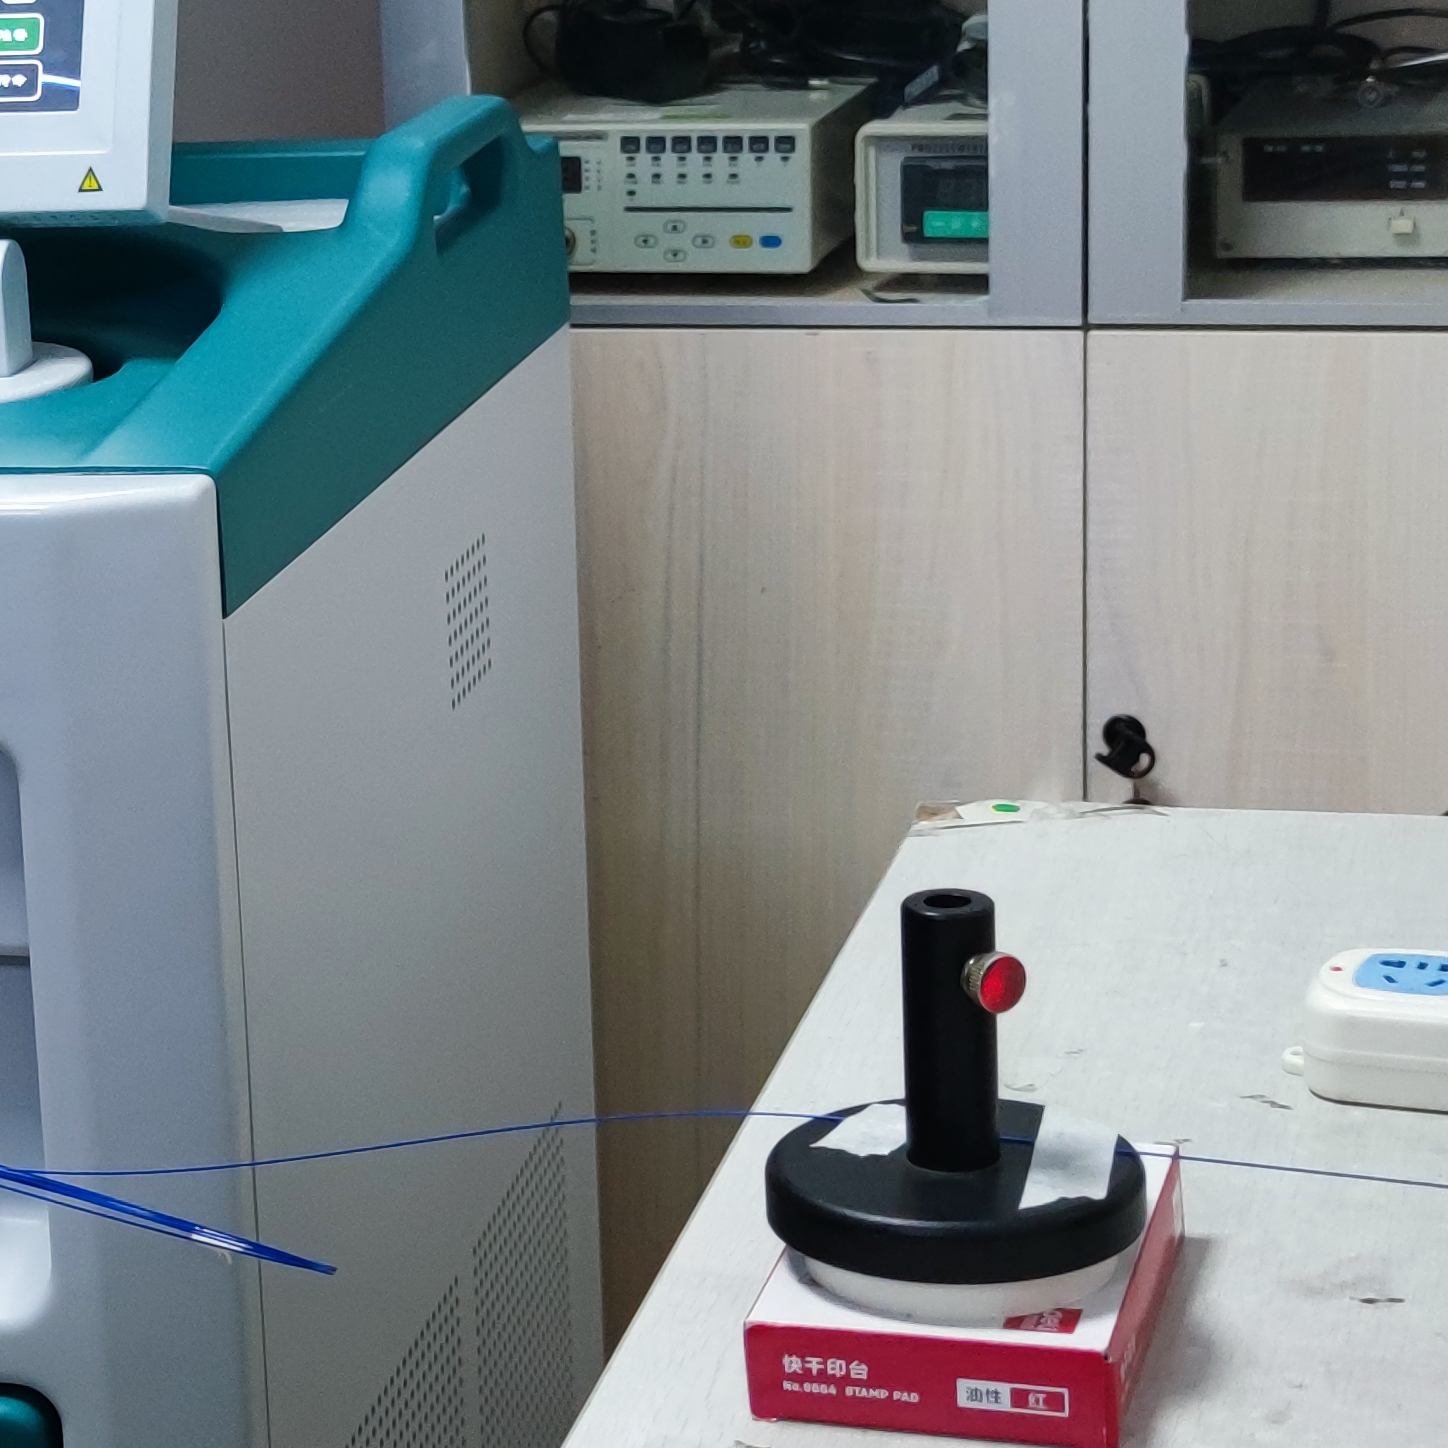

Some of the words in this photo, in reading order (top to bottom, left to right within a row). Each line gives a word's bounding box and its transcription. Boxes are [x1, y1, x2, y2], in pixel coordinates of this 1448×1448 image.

[781, 1353, 869, 1381] 快干印台
[844, 1386, 889, 1400] STAMP
[965, 1385, 1002, 1405] 油性
[1027, 1392, 1047, 1409] 红
